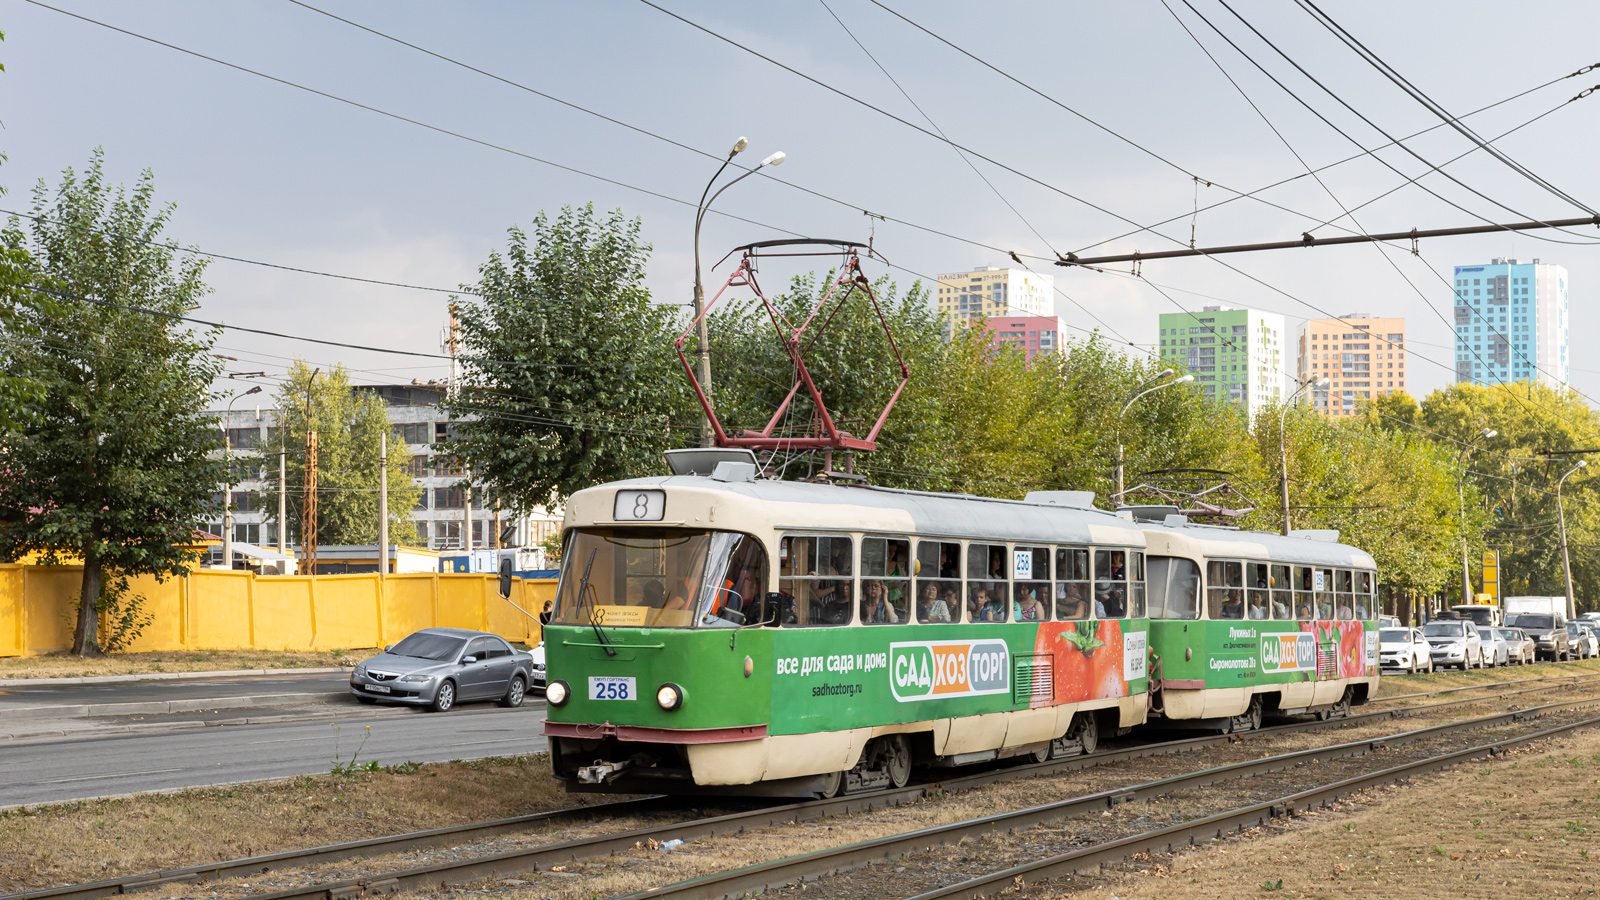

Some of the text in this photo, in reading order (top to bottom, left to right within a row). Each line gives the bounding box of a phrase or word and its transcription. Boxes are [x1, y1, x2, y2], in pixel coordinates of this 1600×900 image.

[633, 493, 648, 518] 8
[1016, 554, 1030, 570] 258
[595, 608, 605, 625] 8
[1229, 627, 1251, 640] Лукиных
[1262, 640, 1314, 664] САД ХОЗ ТОРГ
[776, 652, 887, 677] все для сада и дома
[895, 651, 1005, 688] САД ХОЗ ТОРГ
[1210, 657, 1248, 672] Сыромолотова
[595, 682, 628, 699] 258
[812, 683, 862, 697] sadhoztorg.ru
